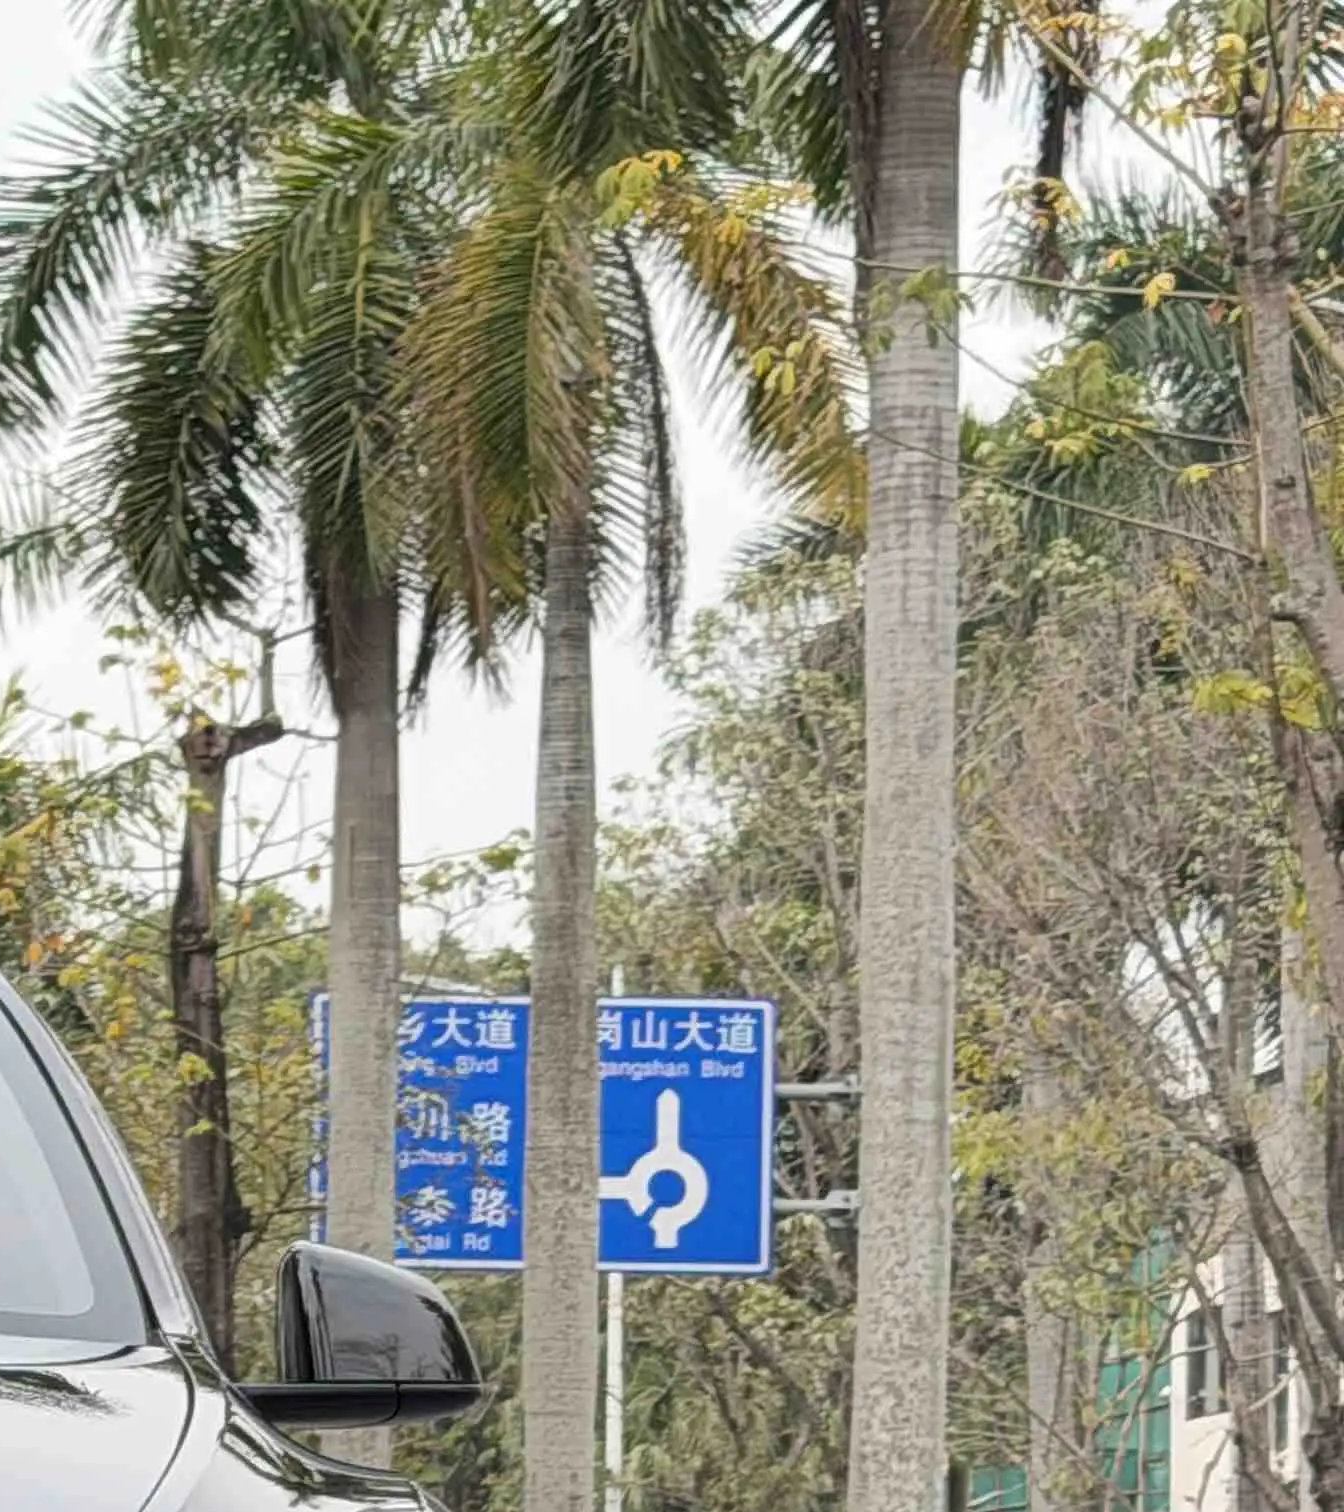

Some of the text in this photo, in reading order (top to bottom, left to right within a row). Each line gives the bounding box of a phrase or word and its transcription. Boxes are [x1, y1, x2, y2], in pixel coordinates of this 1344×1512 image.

[396, 1007, 517, 1050] 乡大道
[596, 1010, 758, 1054] 岗山大道
[597, 1058, 745, 1081] gangshan Blvd
[408, 1186, 509, 1229] 泰路
